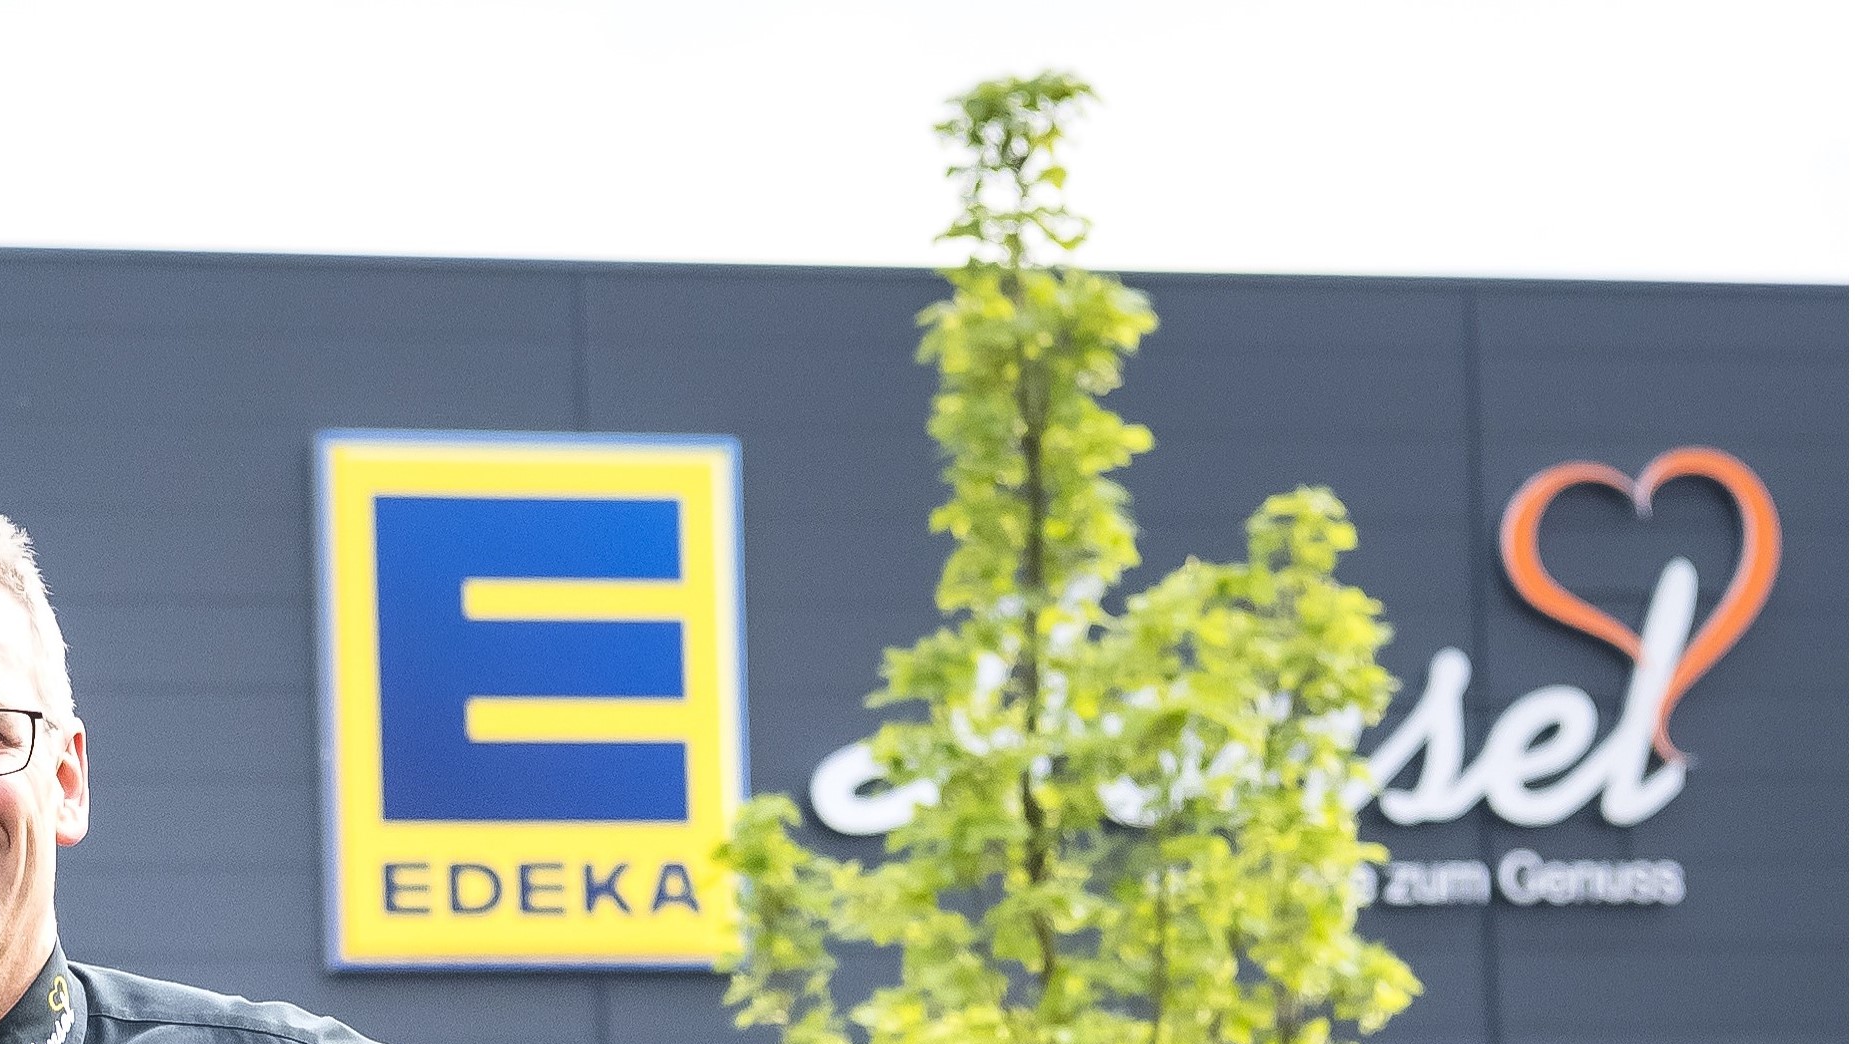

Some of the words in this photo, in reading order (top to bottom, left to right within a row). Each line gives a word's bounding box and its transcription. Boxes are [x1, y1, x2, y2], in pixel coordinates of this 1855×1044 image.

[808, 556, 1698, 835] sel
[383, 862, 701, 915] EDEKA
[1384, 860, 1492, 905] zum
[1496, 848, 1686, 906] Genuss
